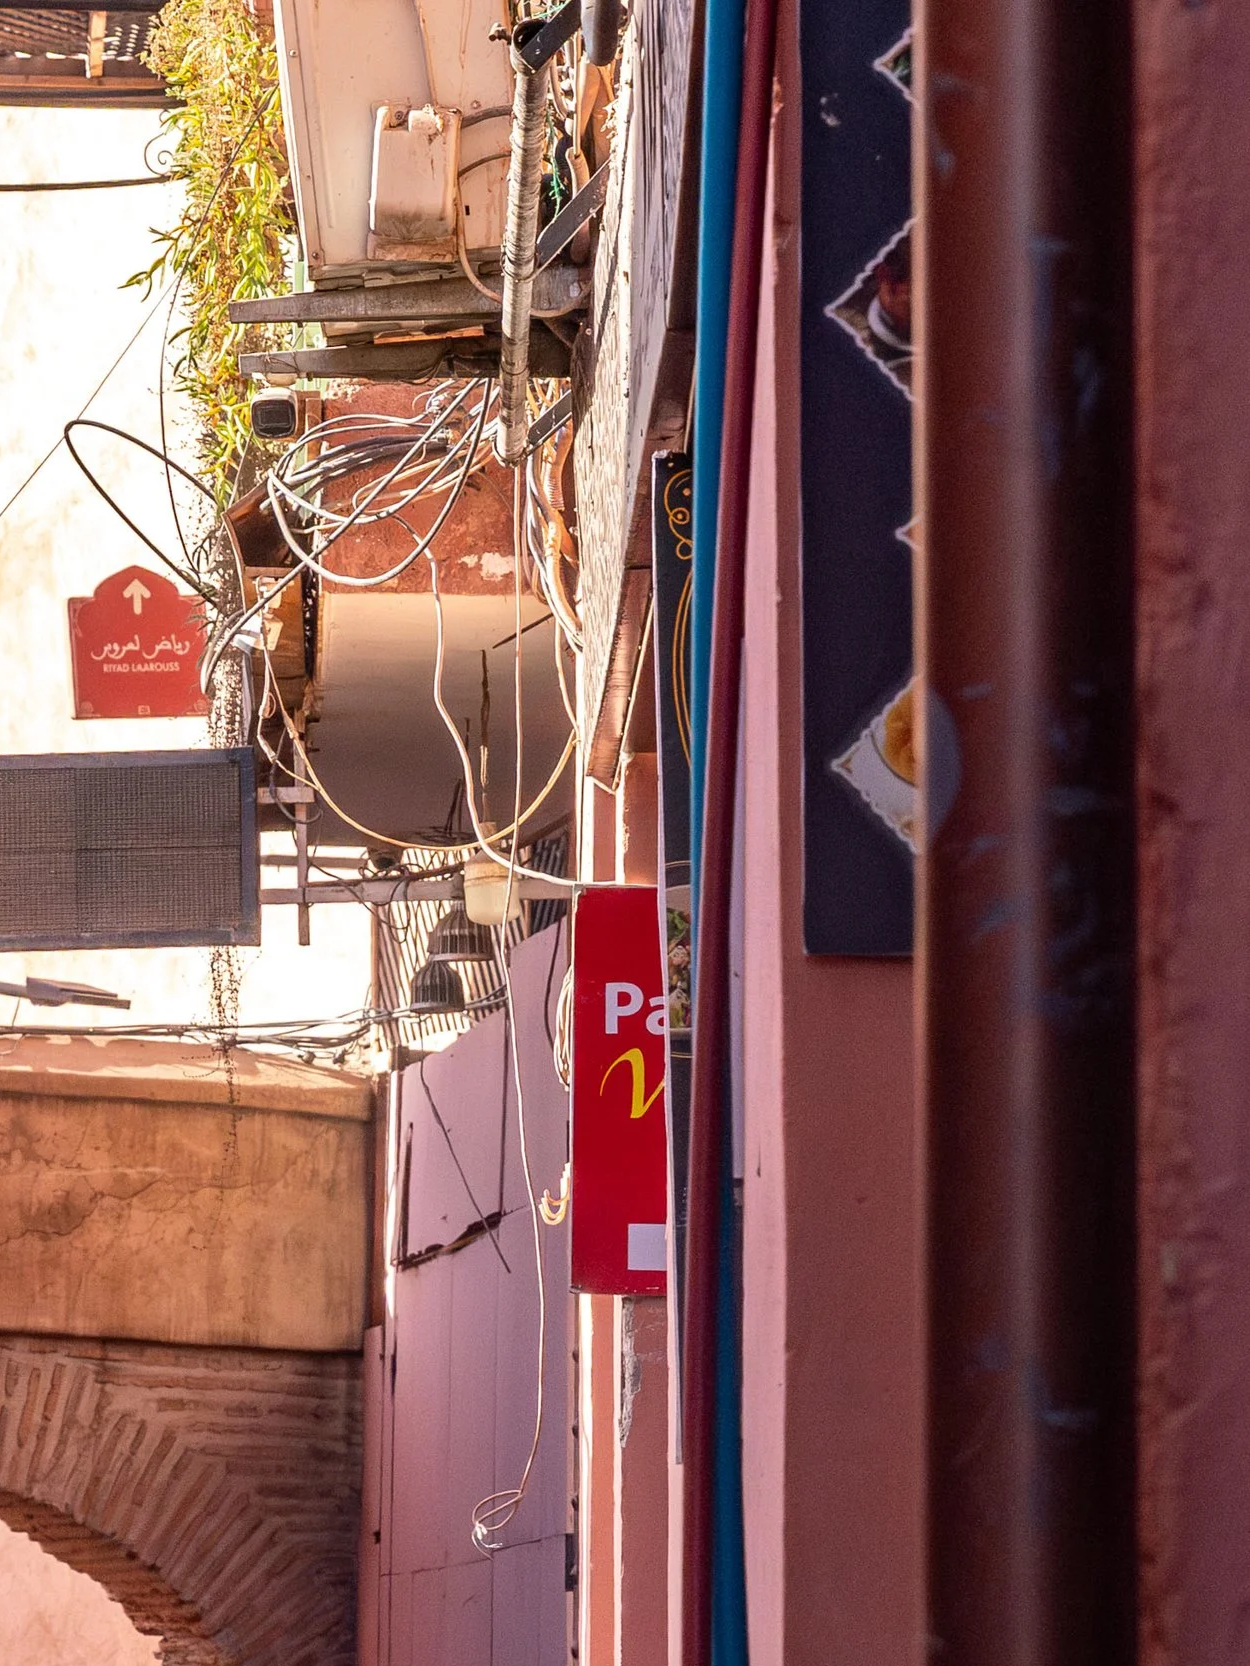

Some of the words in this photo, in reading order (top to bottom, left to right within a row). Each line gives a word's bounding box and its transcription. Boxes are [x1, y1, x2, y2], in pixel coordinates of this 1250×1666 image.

[142, 633, 190, 660] رياض
[103, 663, 130, 673] RIYAD
[132, 662, 180, 672] LAAROUSS
